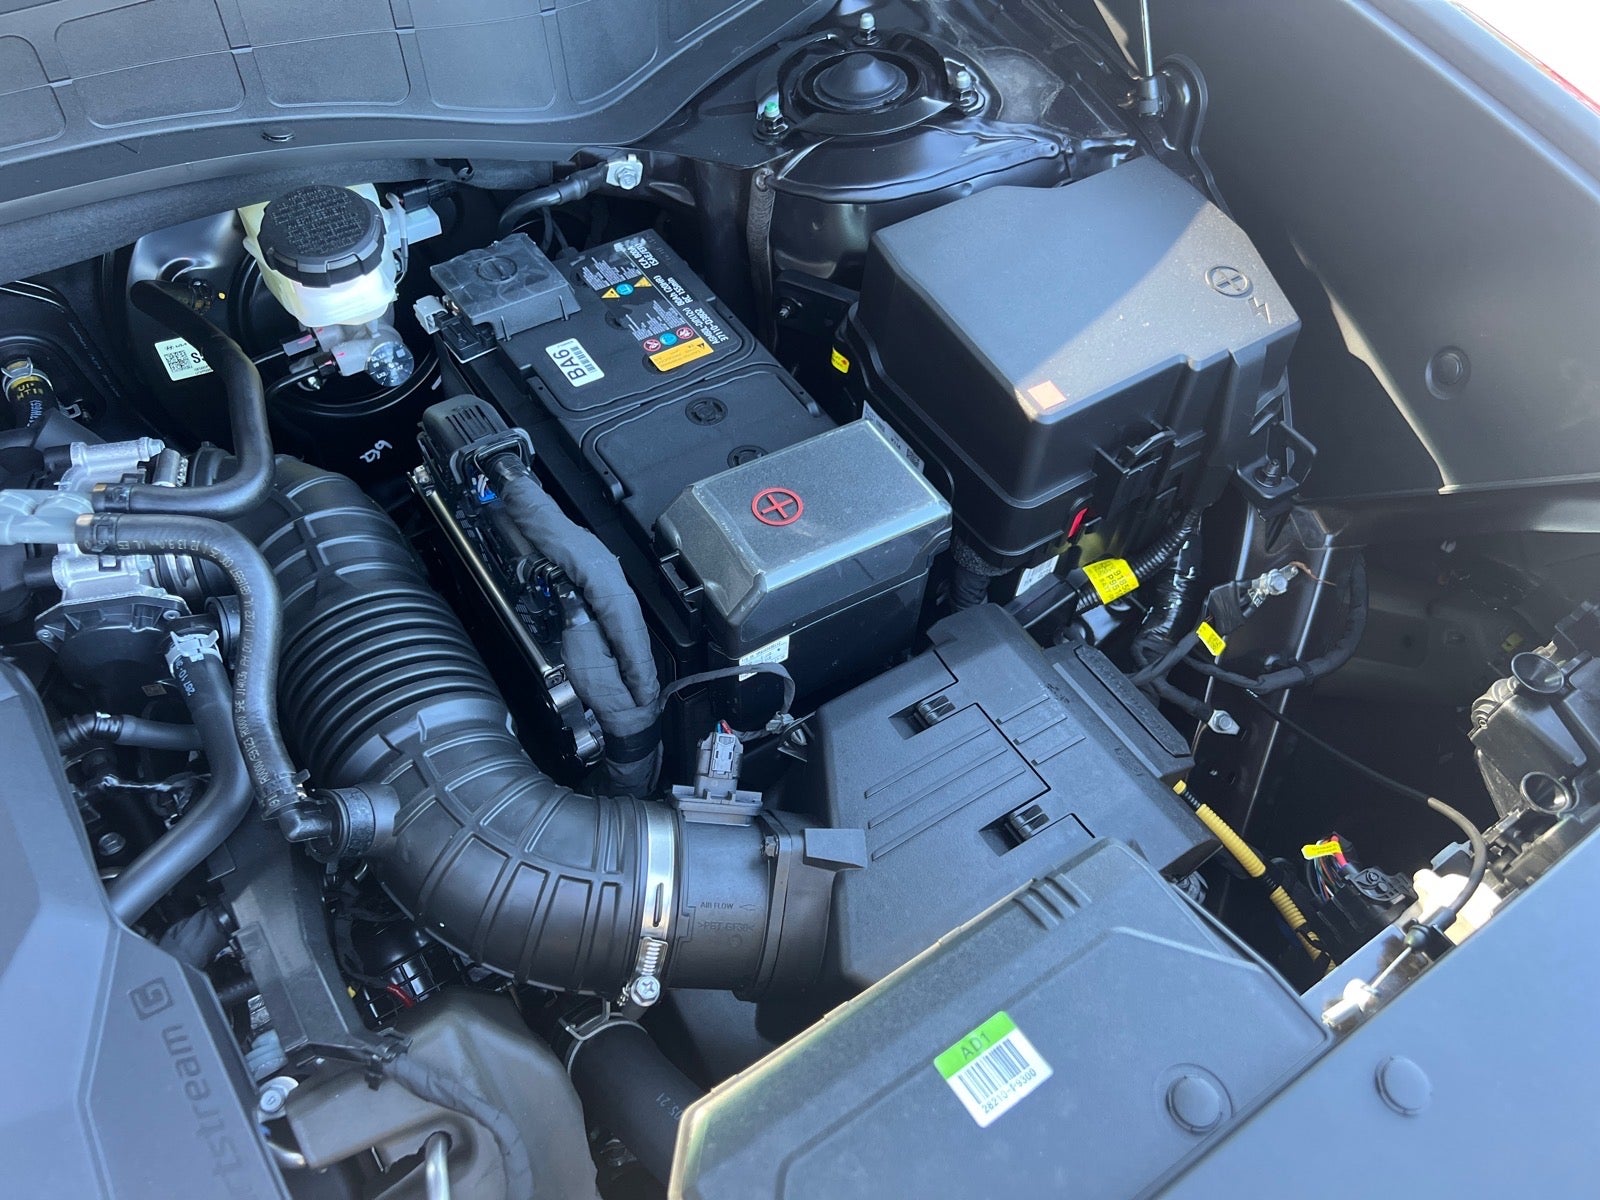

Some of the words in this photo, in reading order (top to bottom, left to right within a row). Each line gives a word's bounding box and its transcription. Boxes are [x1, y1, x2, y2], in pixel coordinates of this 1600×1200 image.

[682, 292, 694, 305] RC
[552, 348, 588, 381] BA6
[699, 901, 712, 909] AIR
[712, 901, 734, 910] FLOW
[959, 1031, 992, 1060] AD1
[981, 1068, 1038, 1115] 28210-P9300
